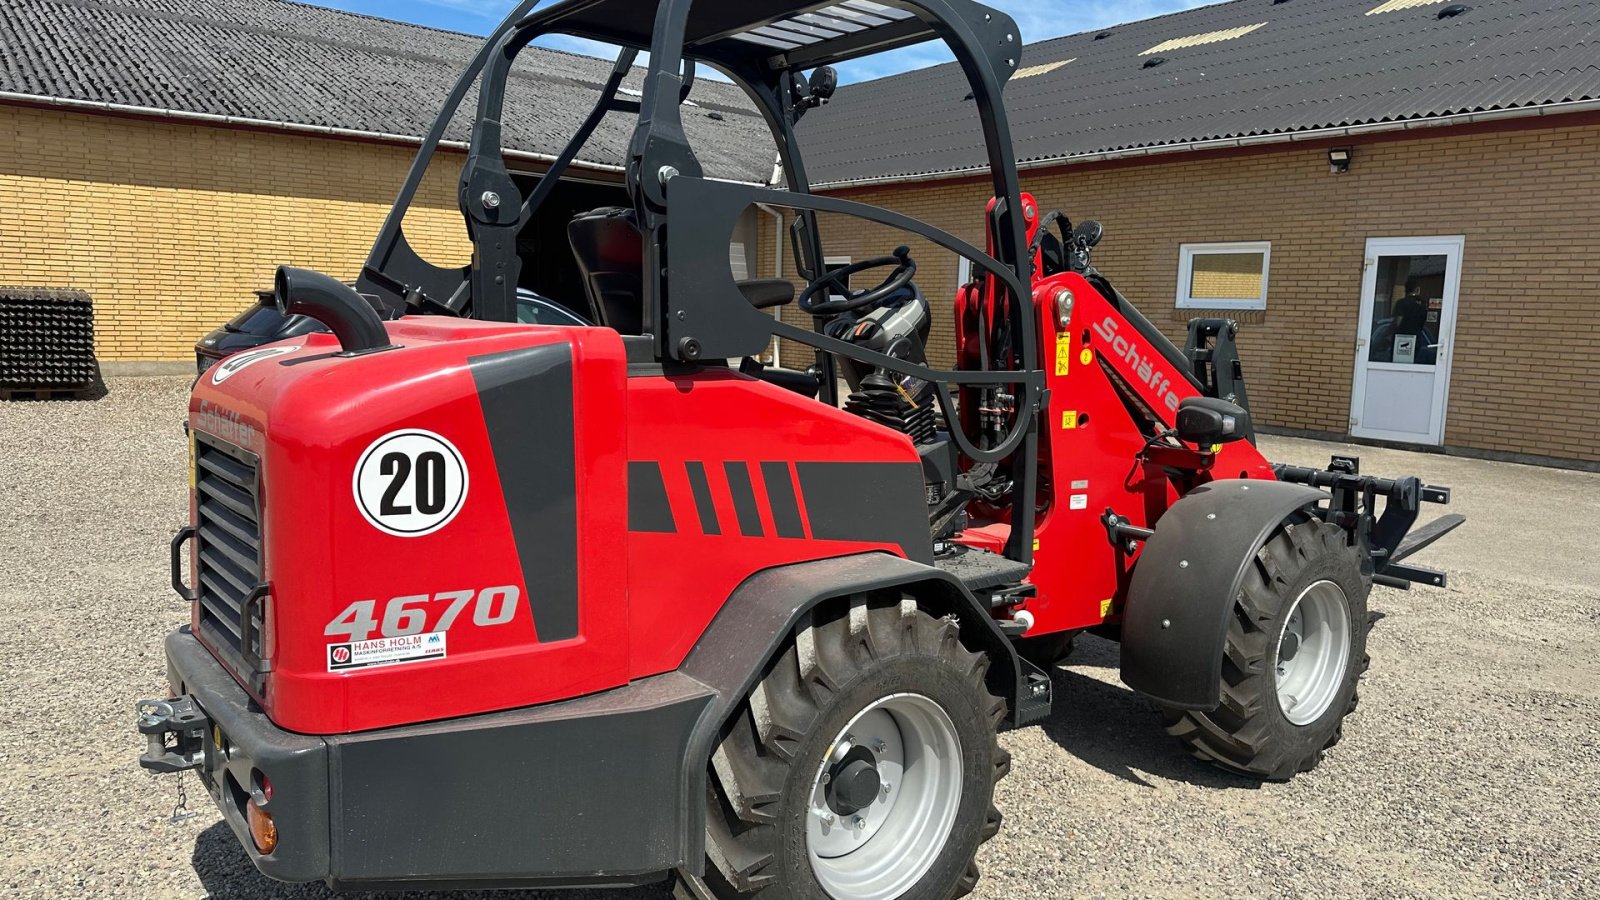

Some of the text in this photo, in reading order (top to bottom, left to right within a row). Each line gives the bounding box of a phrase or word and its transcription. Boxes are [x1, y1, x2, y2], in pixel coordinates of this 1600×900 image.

[1092, 316, 1180, 413] Schäffe
[196, 399, 255, 448] Schäffer
[379, 450, 446, 516] 20
[323, 584, 521, 642] 4670
[354, 636, 422, 651] HANS HOLM
